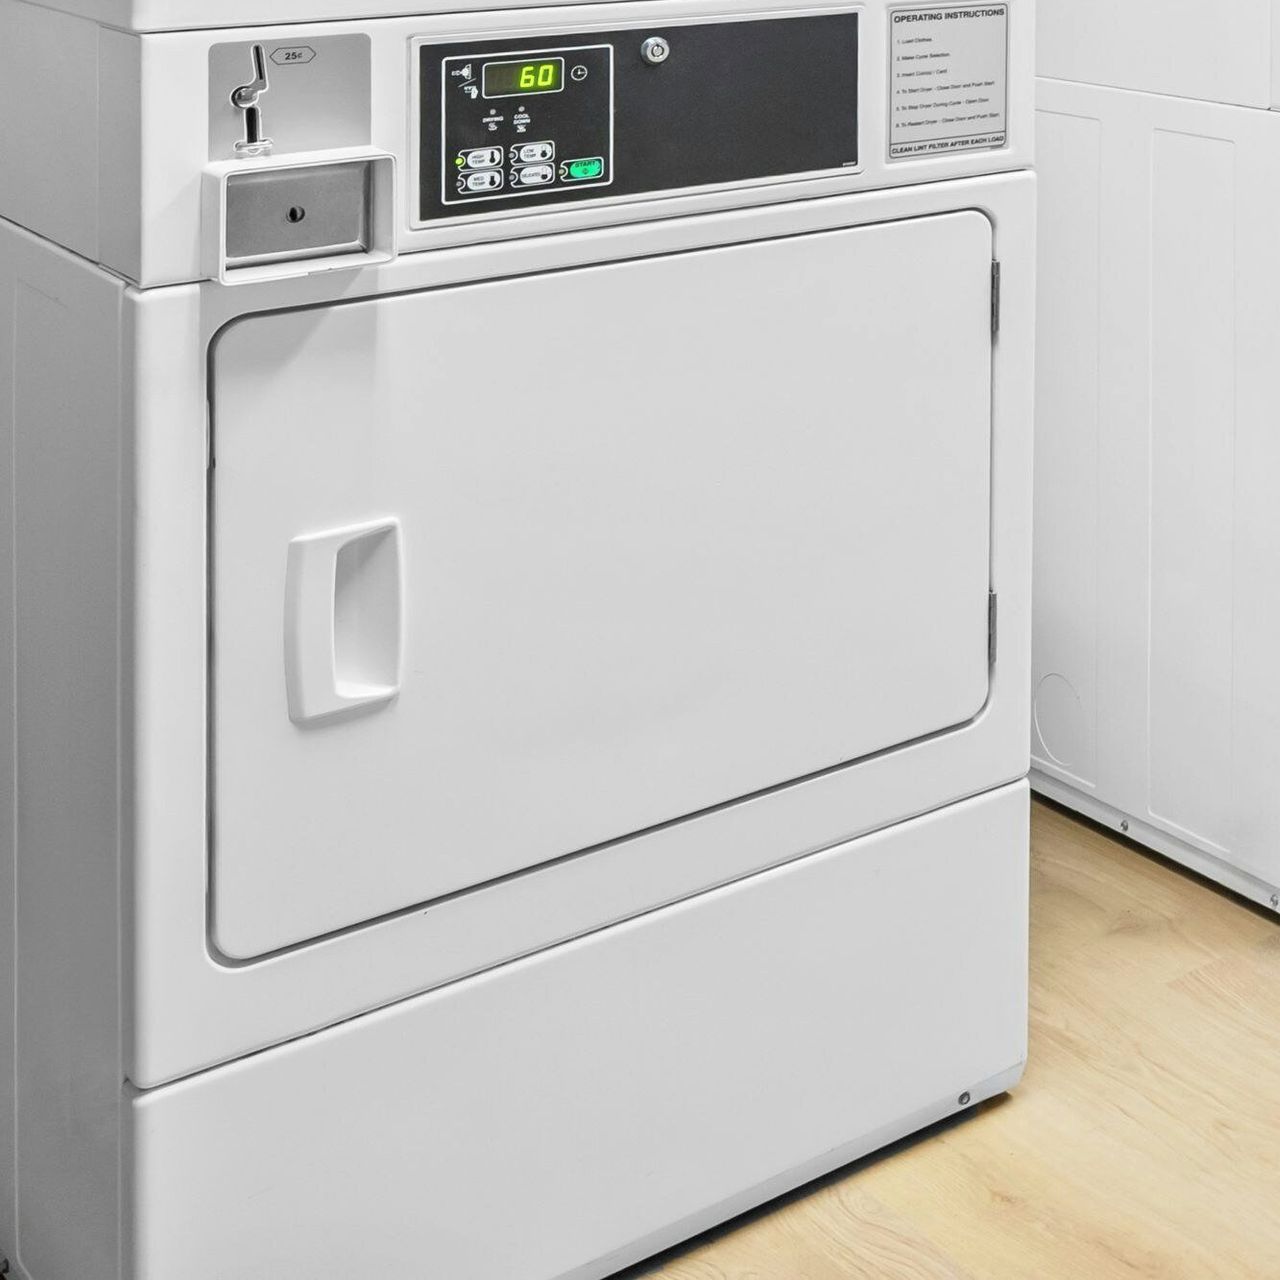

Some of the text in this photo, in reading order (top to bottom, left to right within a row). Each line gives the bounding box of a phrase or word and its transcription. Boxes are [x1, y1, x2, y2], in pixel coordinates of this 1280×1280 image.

[893, 8, 1005, 23] OPERATING INSTRUCTIONS
[520, 64, 554, 88] 60
[891, 146, 913, 155] CLEAN
